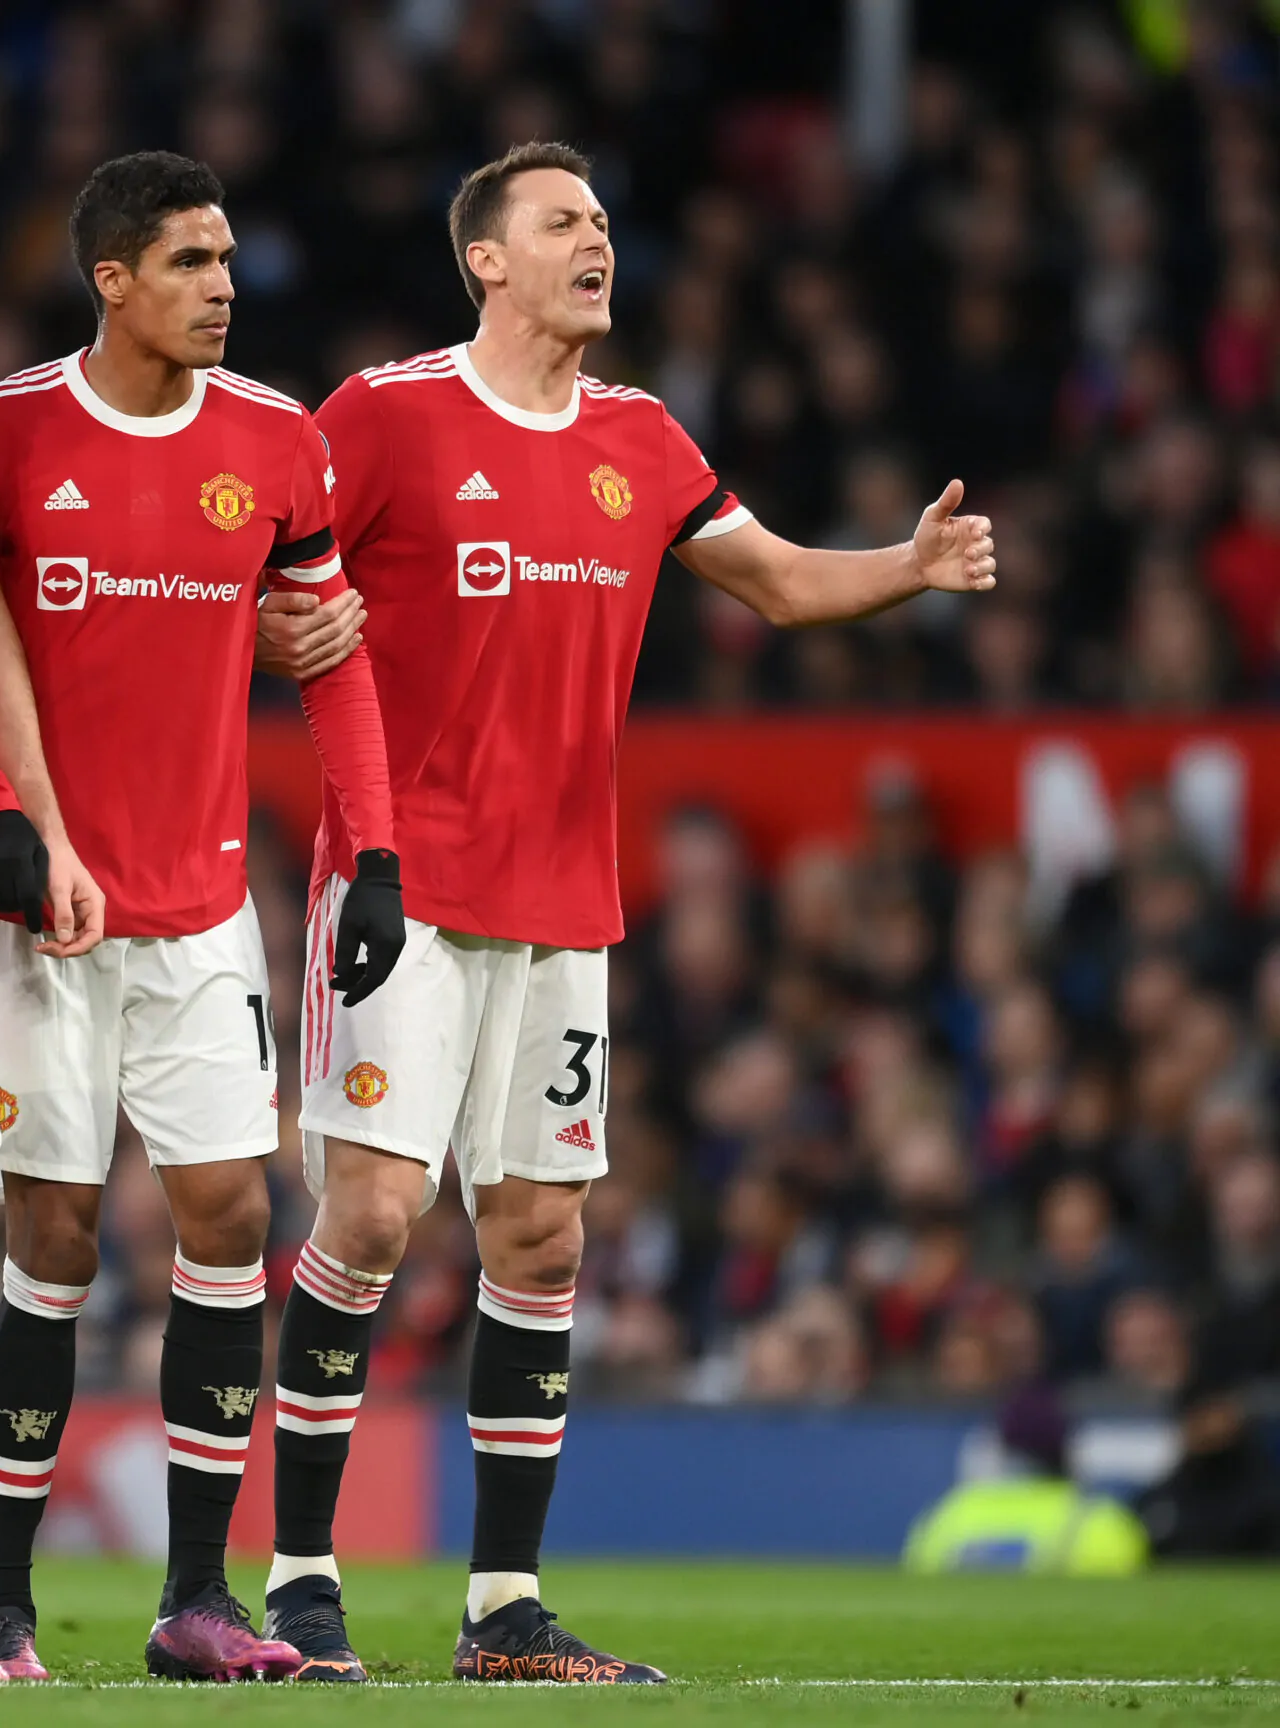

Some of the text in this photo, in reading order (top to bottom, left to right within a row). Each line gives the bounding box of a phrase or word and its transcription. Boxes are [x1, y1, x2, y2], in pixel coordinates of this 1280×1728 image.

[205, 477, 250, 497] MANCHESTER
[456, 487, 499, 500] adidas
[44, 497, 90, 510] adidas
[213, 516, 243, 527] UNITED
[514, 556, 630, 588] TeamViewer
[91, 571, 242, 602] TeamViewer
[555, 1131, 596, 1151] adidas
